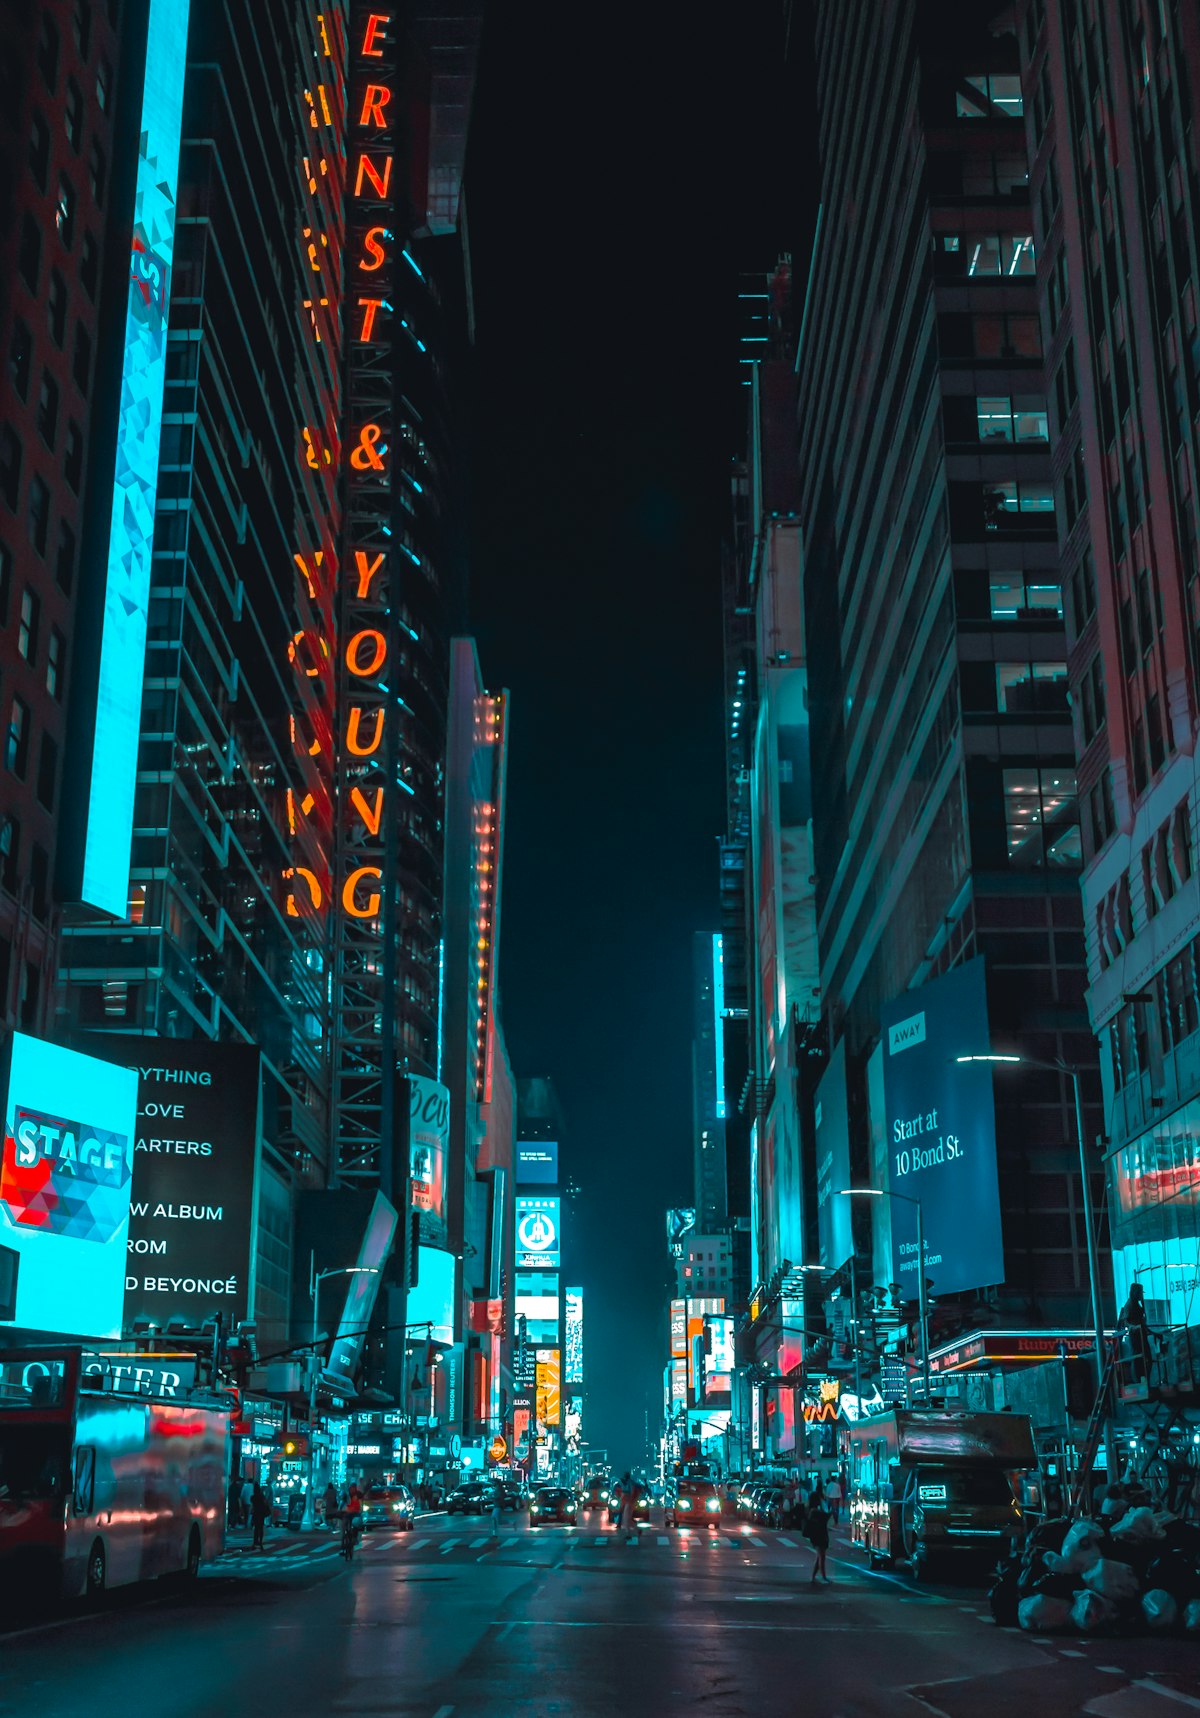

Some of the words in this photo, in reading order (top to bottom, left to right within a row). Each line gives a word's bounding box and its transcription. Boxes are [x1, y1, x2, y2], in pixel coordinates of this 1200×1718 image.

[354, 14, 393, 342] ERNST
[350, 423, 386, 471] &
[342, 551, 387, 918] YOUNG
[894, 1023, 921, 1045] AWAY
[128, 1067, 212, 1086] YTHING
[893, 1114, 923, 1143] Start
[926, 1108, 938, 1131] at
[895, 1151, 910, 1177] 10
[912, 1136, 945, 1172] Bond
[946, 1134, 964, 1161] St.
[130, 1203, 149, 1216] W
[153, 1203, 223, 1220] ALBUM
[125, 1276, 139, 1290] D
[143, 1275, 237, 1294] BEYONCÉ
[1018, 1338, 1056, 1352] Ruby
[446, 1461, 462, 1470] CASE
